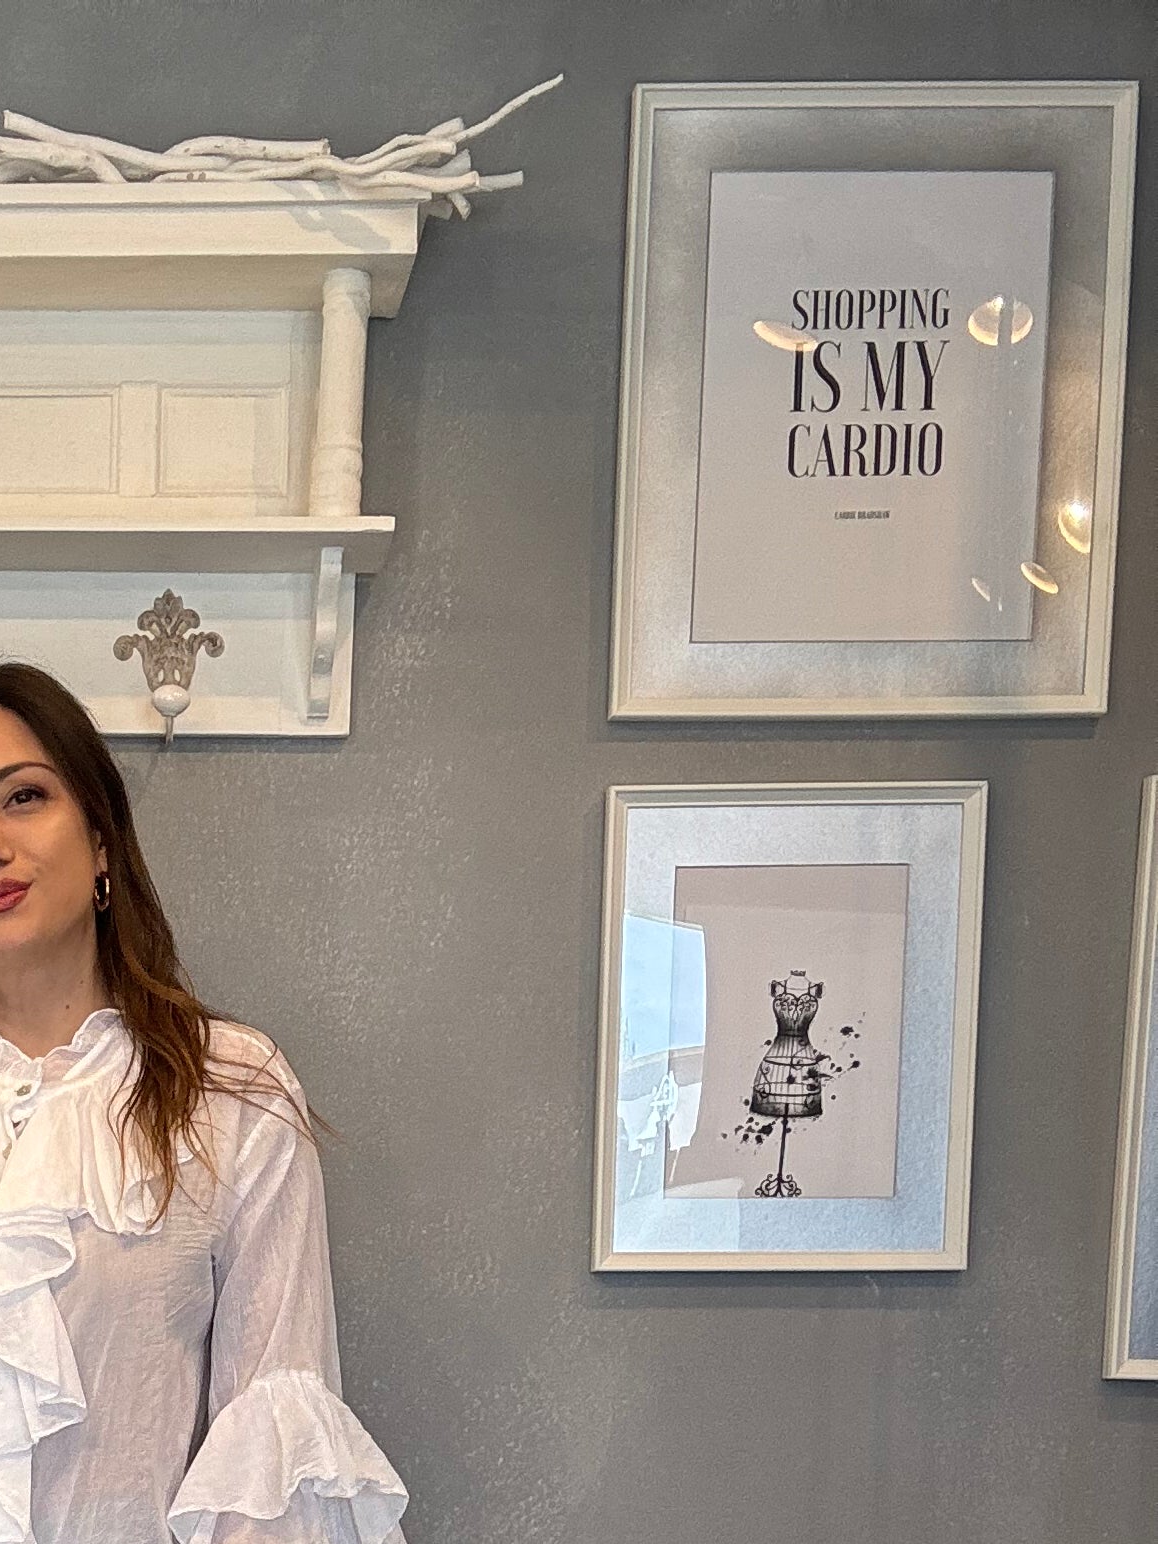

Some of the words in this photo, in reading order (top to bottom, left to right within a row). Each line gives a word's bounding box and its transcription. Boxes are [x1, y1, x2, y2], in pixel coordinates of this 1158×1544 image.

[792, 288, 950, 331] SHOPPING
[790, 340, 842, 413] IS
[860, 339, 950, 412] MY
[787, 422, 943, 478] CARDIO
